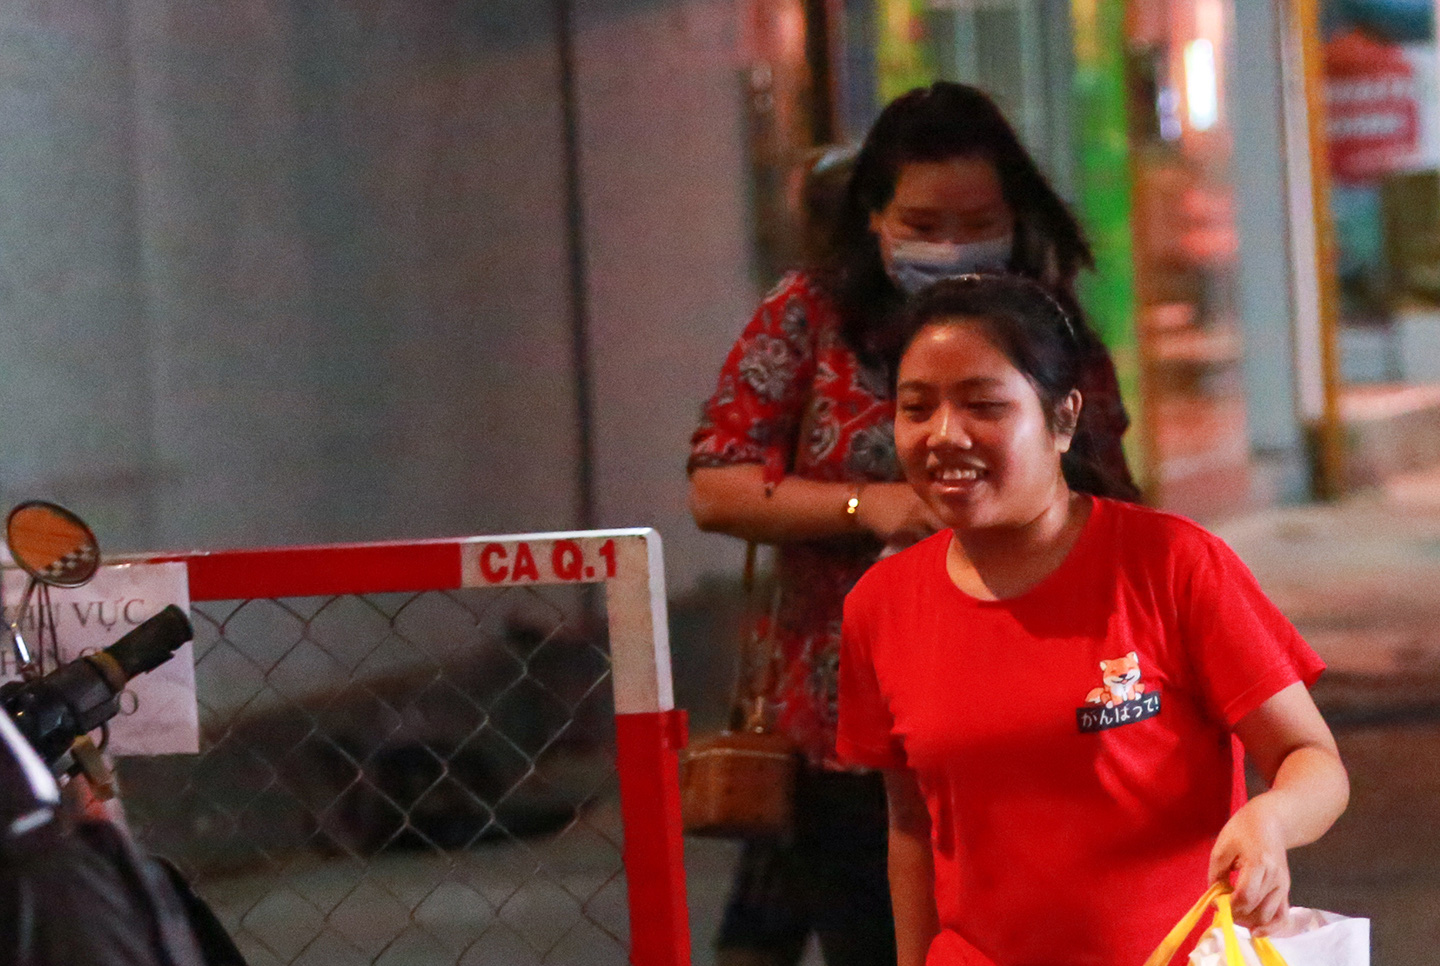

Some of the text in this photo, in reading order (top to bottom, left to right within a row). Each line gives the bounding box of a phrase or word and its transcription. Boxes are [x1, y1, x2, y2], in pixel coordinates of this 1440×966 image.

[480, 539, 616, 583] CA Q.1
[1080, 696, 1159, 728] がんばって!
